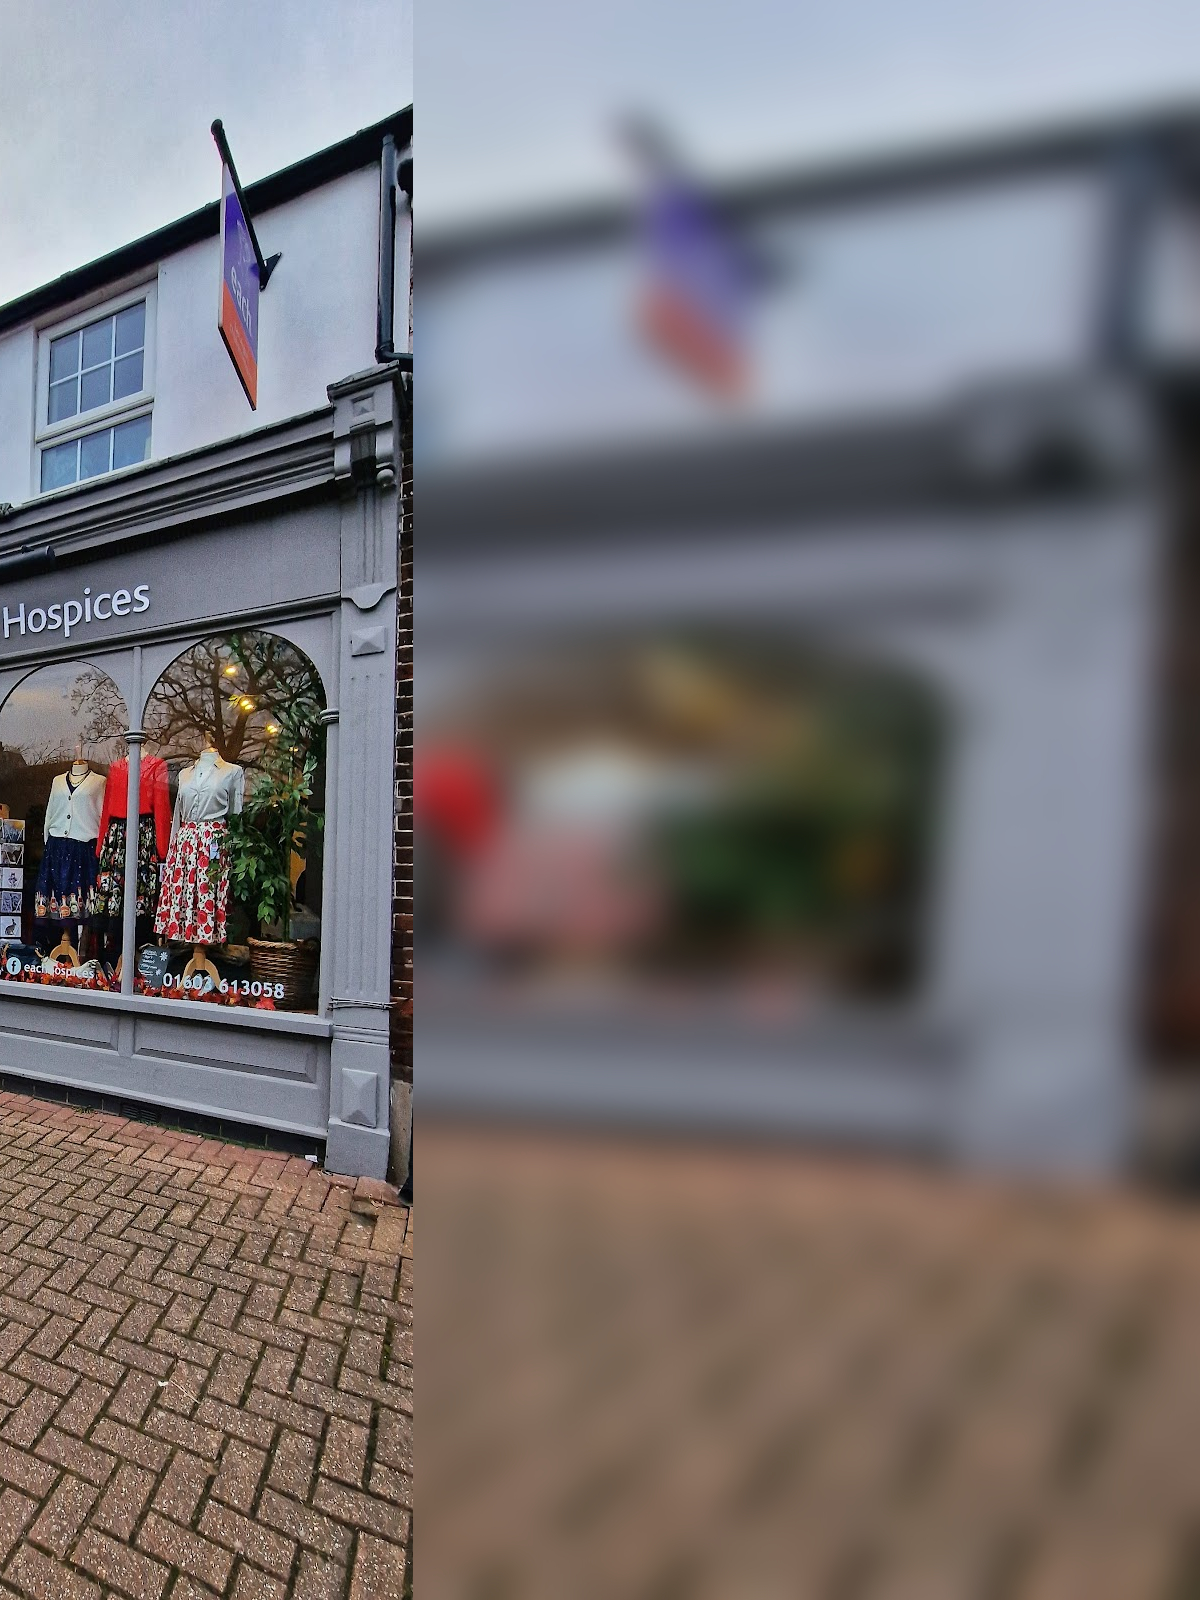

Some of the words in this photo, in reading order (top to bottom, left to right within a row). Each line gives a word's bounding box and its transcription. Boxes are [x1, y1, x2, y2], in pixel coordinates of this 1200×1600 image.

[230, 265, 253, 337] each
[2, 583, 151, 638] Hospices
[24, 963, 95, 979] eachospices
[219, 978, 285, 999] 613058
